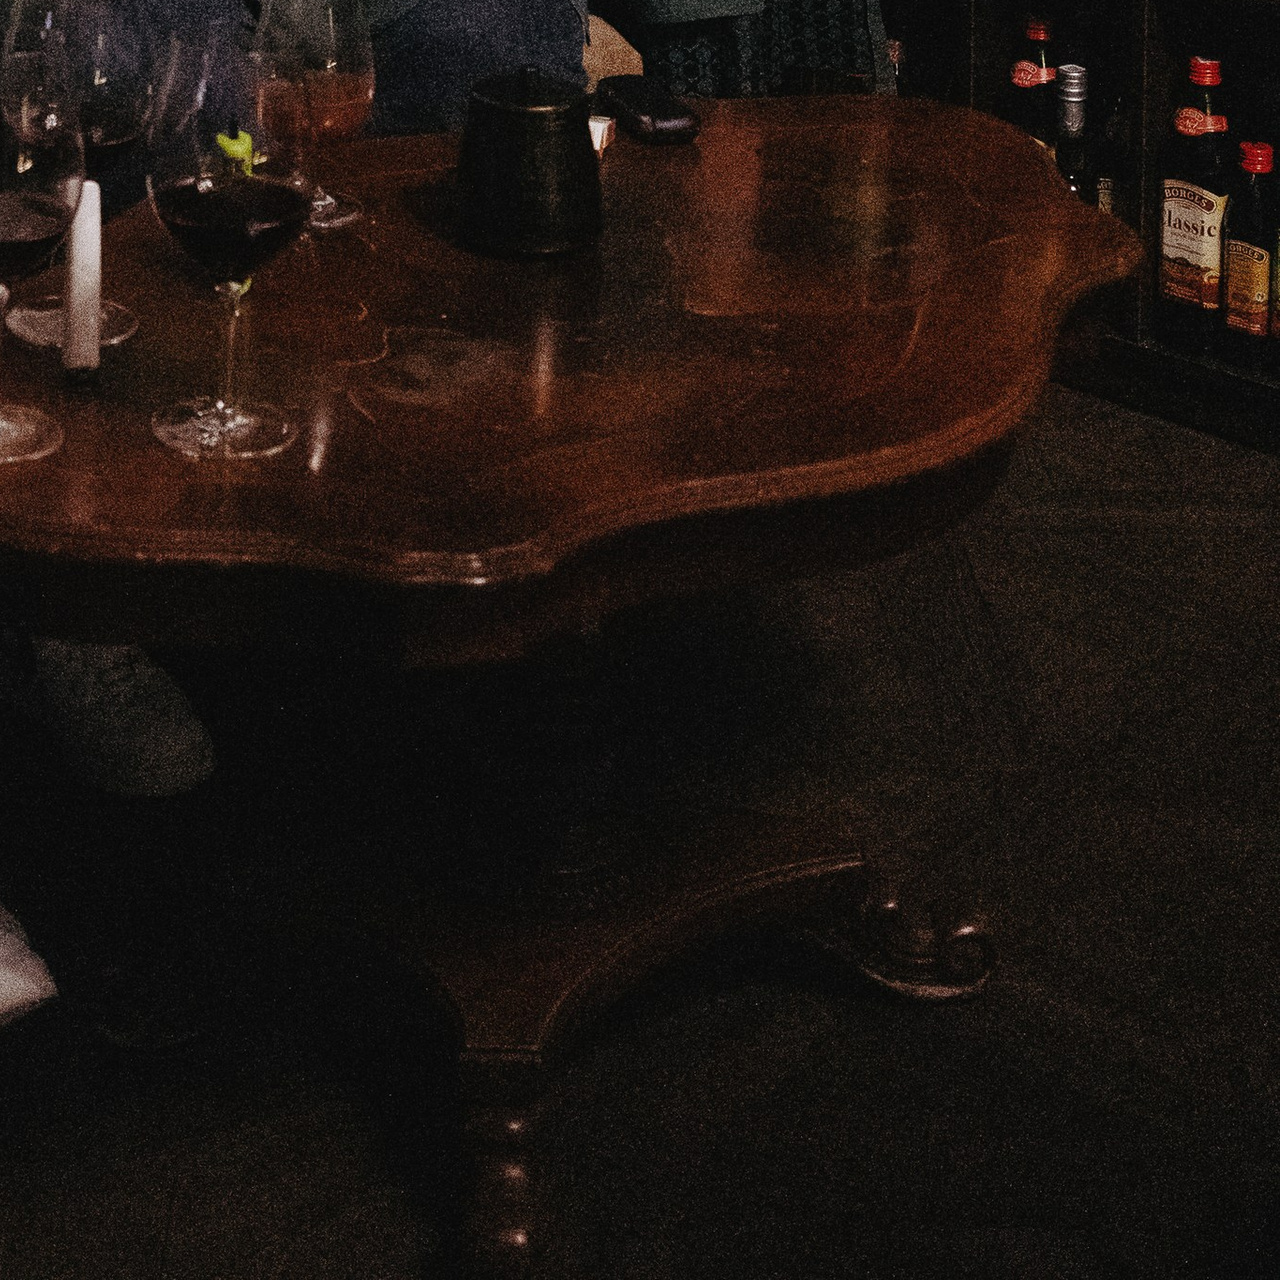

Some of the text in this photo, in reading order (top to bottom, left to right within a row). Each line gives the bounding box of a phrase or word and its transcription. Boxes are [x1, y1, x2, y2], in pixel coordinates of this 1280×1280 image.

[1164, 188, 1207, 208] BORGES
[1165, 210, 1217, 237] lassic
[1229, 243, 1260, 259] ORGES
